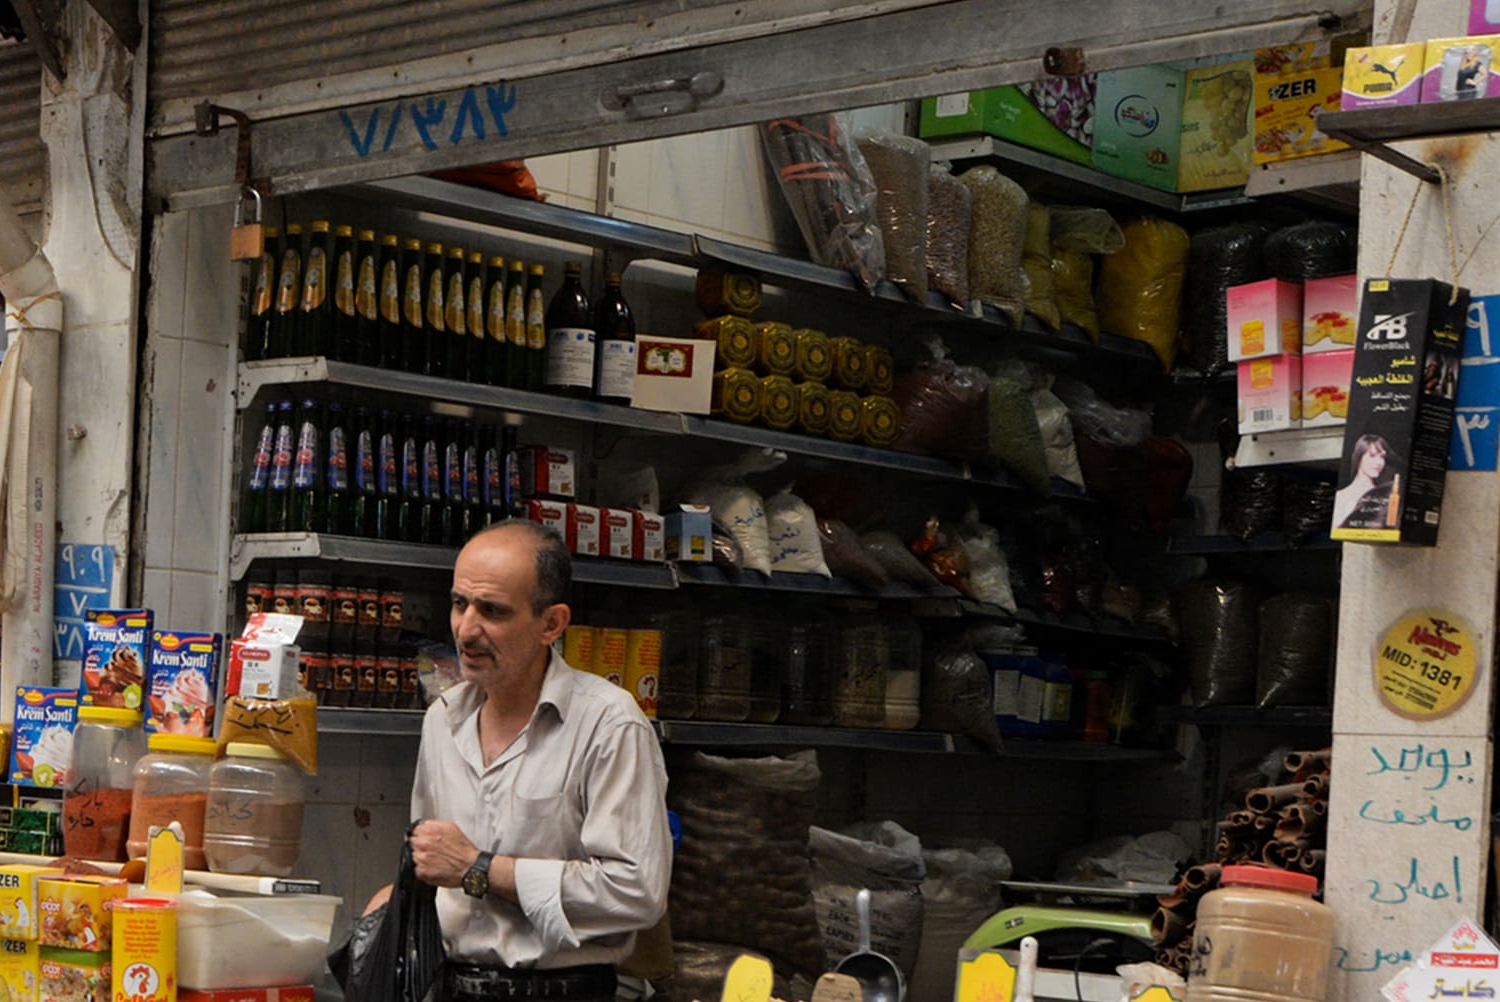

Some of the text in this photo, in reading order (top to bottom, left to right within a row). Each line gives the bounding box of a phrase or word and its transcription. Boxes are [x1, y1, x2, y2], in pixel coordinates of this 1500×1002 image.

[70, 592, 88, 617] ٧
[88, 624, 117, 642] Krem
[152, 649, 180, 667] Krem
[1382, 645, 1418, 670] MID:
[1420, 660, 1463, 691] 1381
[16, 704, 44, 720] Krem
